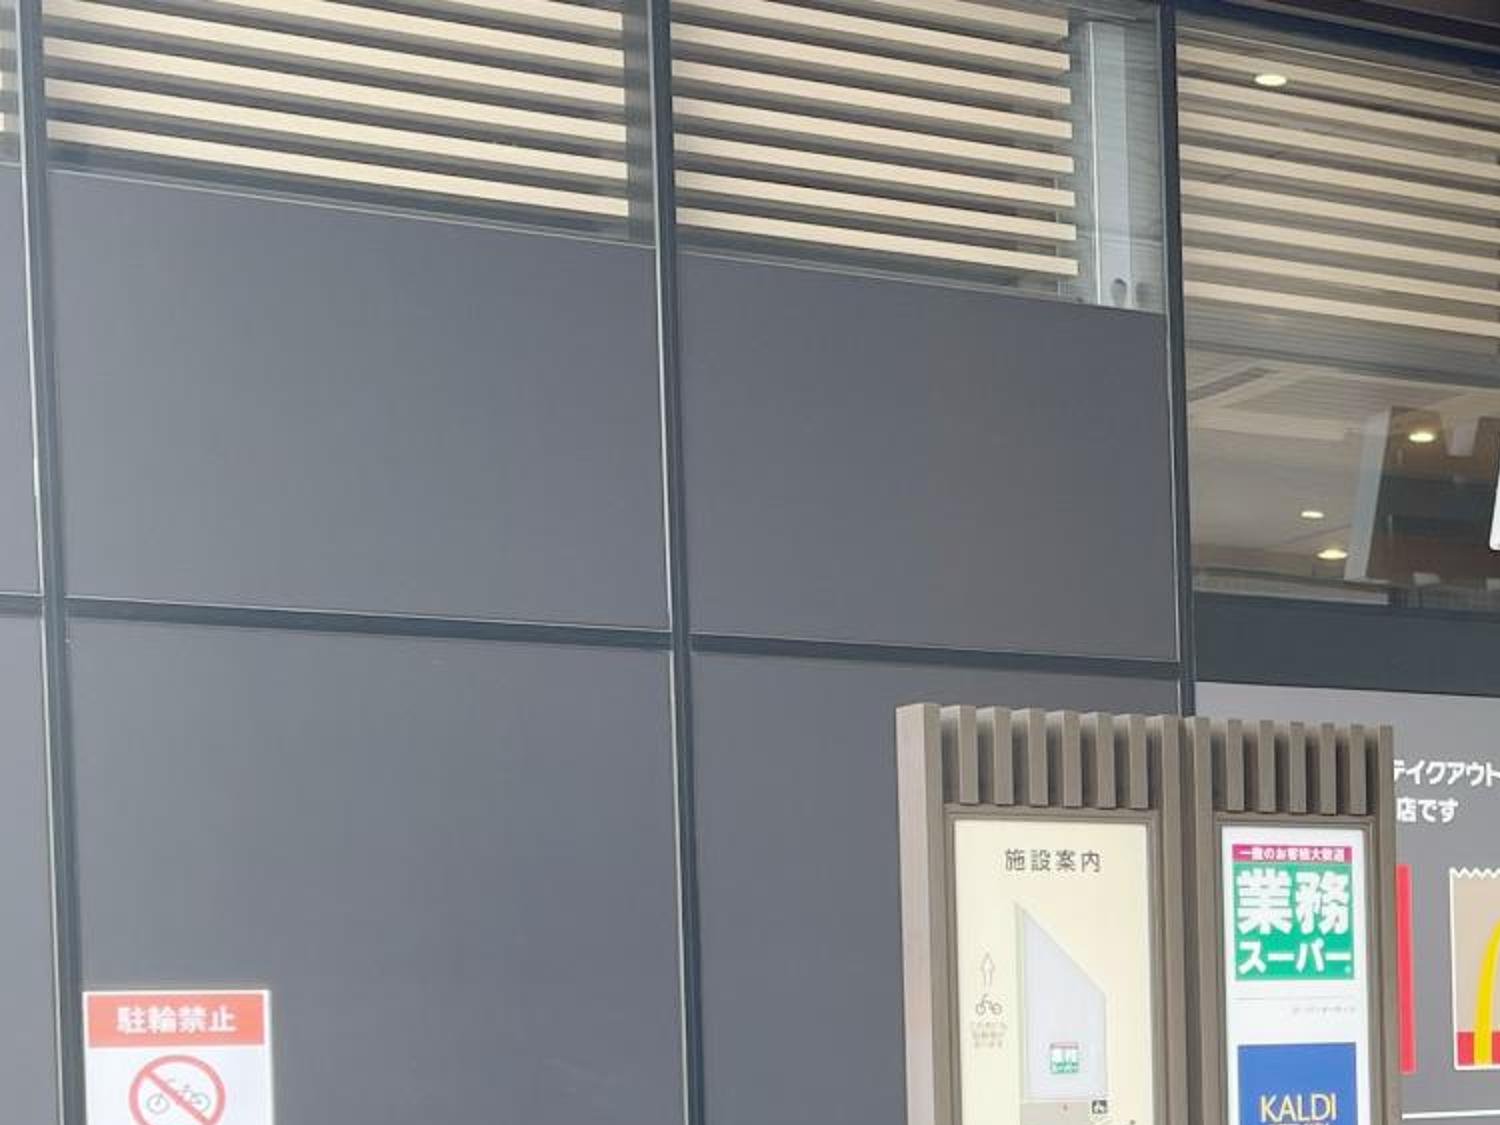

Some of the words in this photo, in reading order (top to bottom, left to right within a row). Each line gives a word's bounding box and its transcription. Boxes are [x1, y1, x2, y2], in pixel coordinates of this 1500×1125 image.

[1396, 798, 1458, 823] 店です
[1005, 849, 1101, 872] 施設案内
[1236, 868, 1350, 935] 業務
[1238, 938, 1351, 974] スーパー
[116, 1006, 236, 1034] 駐輪禁止
[1260, 1092, 1337, 1123] KALDI
